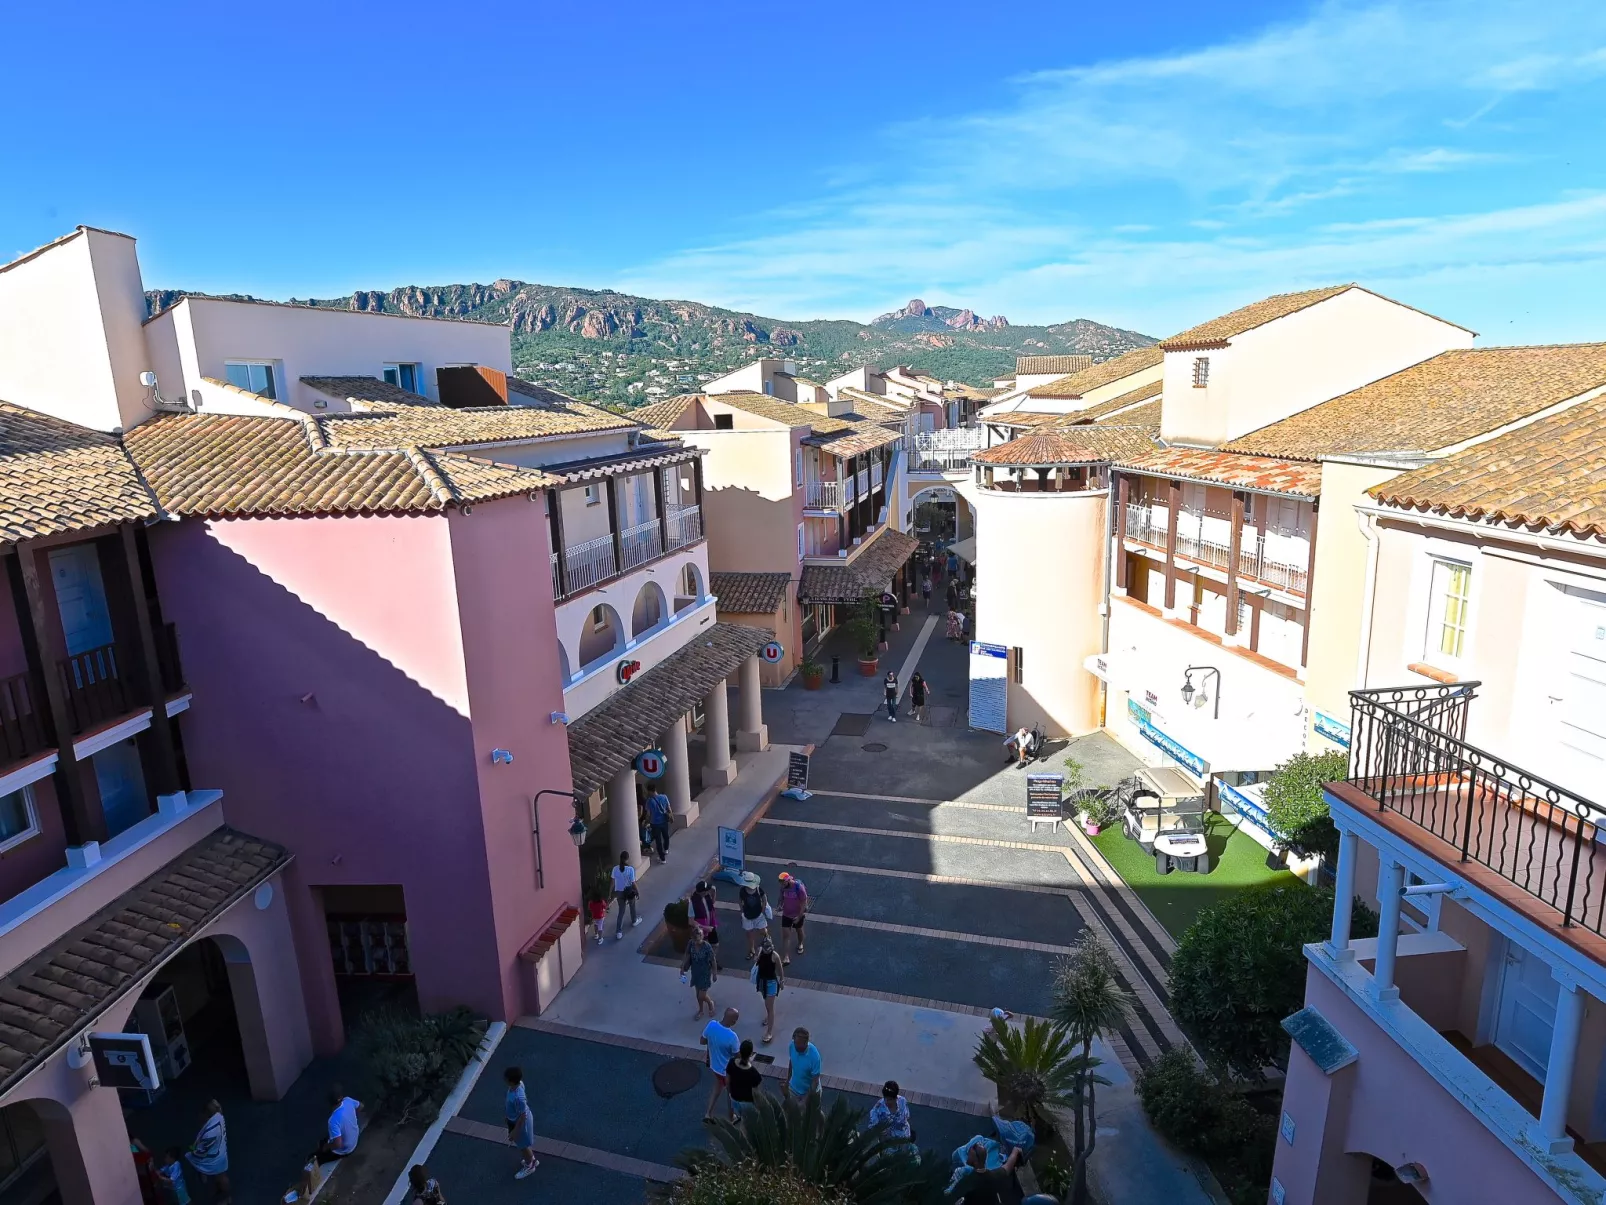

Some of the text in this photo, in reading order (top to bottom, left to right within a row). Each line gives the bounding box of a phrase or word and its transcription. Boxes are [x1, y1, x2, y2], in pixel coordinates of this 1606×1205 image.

[766, 648, 777, 659] U
[1146, 690, 1158, 702] TEAM
[643, 759, 658, 773] U
